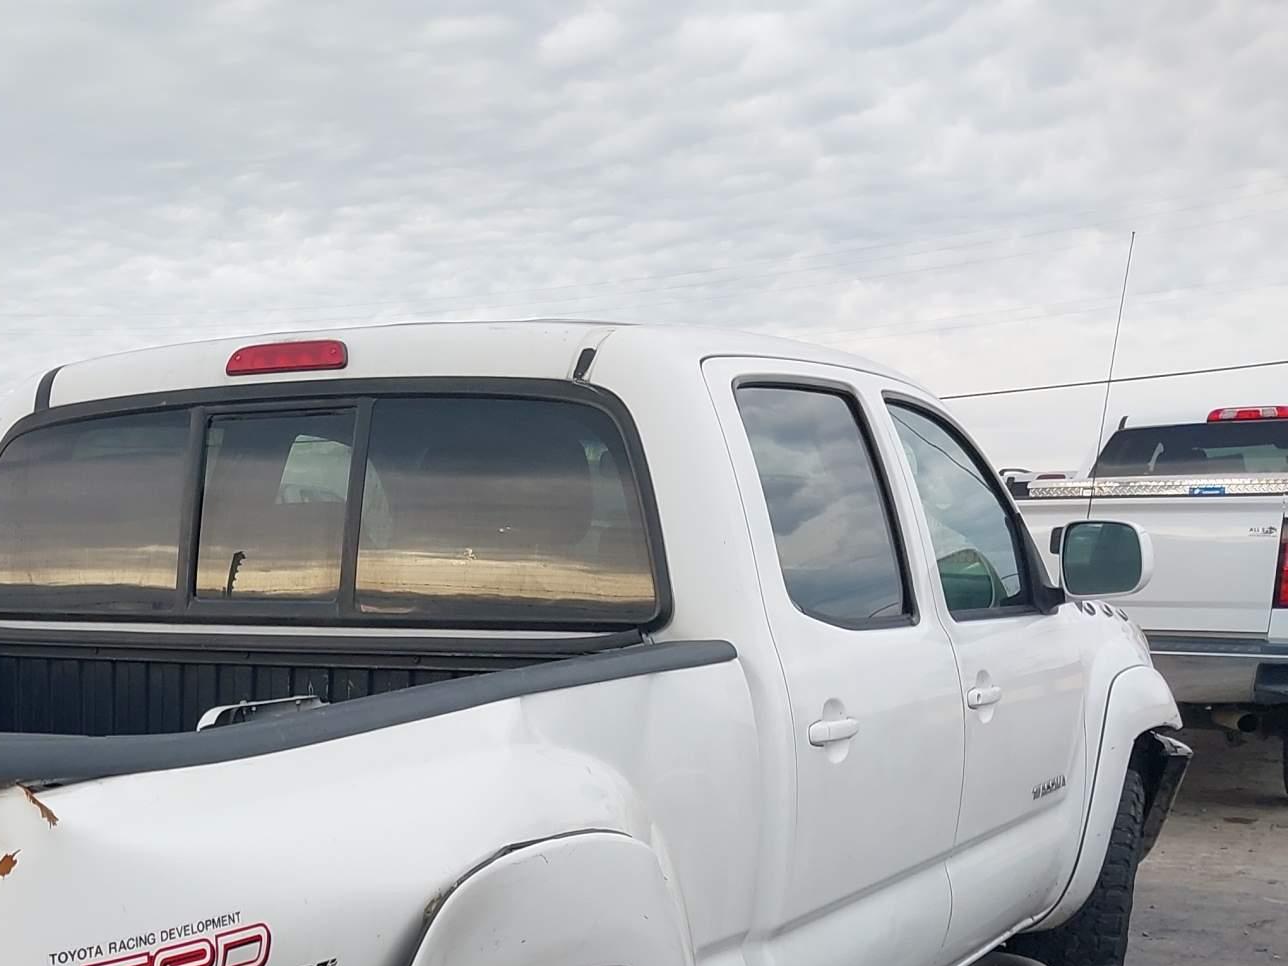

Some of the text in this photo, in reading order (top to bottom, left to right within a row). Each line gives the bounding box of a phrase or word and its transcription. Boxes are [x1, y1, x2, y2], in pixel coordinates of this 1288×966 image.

[48, 911, 241, 966] TOYOTA RACING DEVELOPMENT
